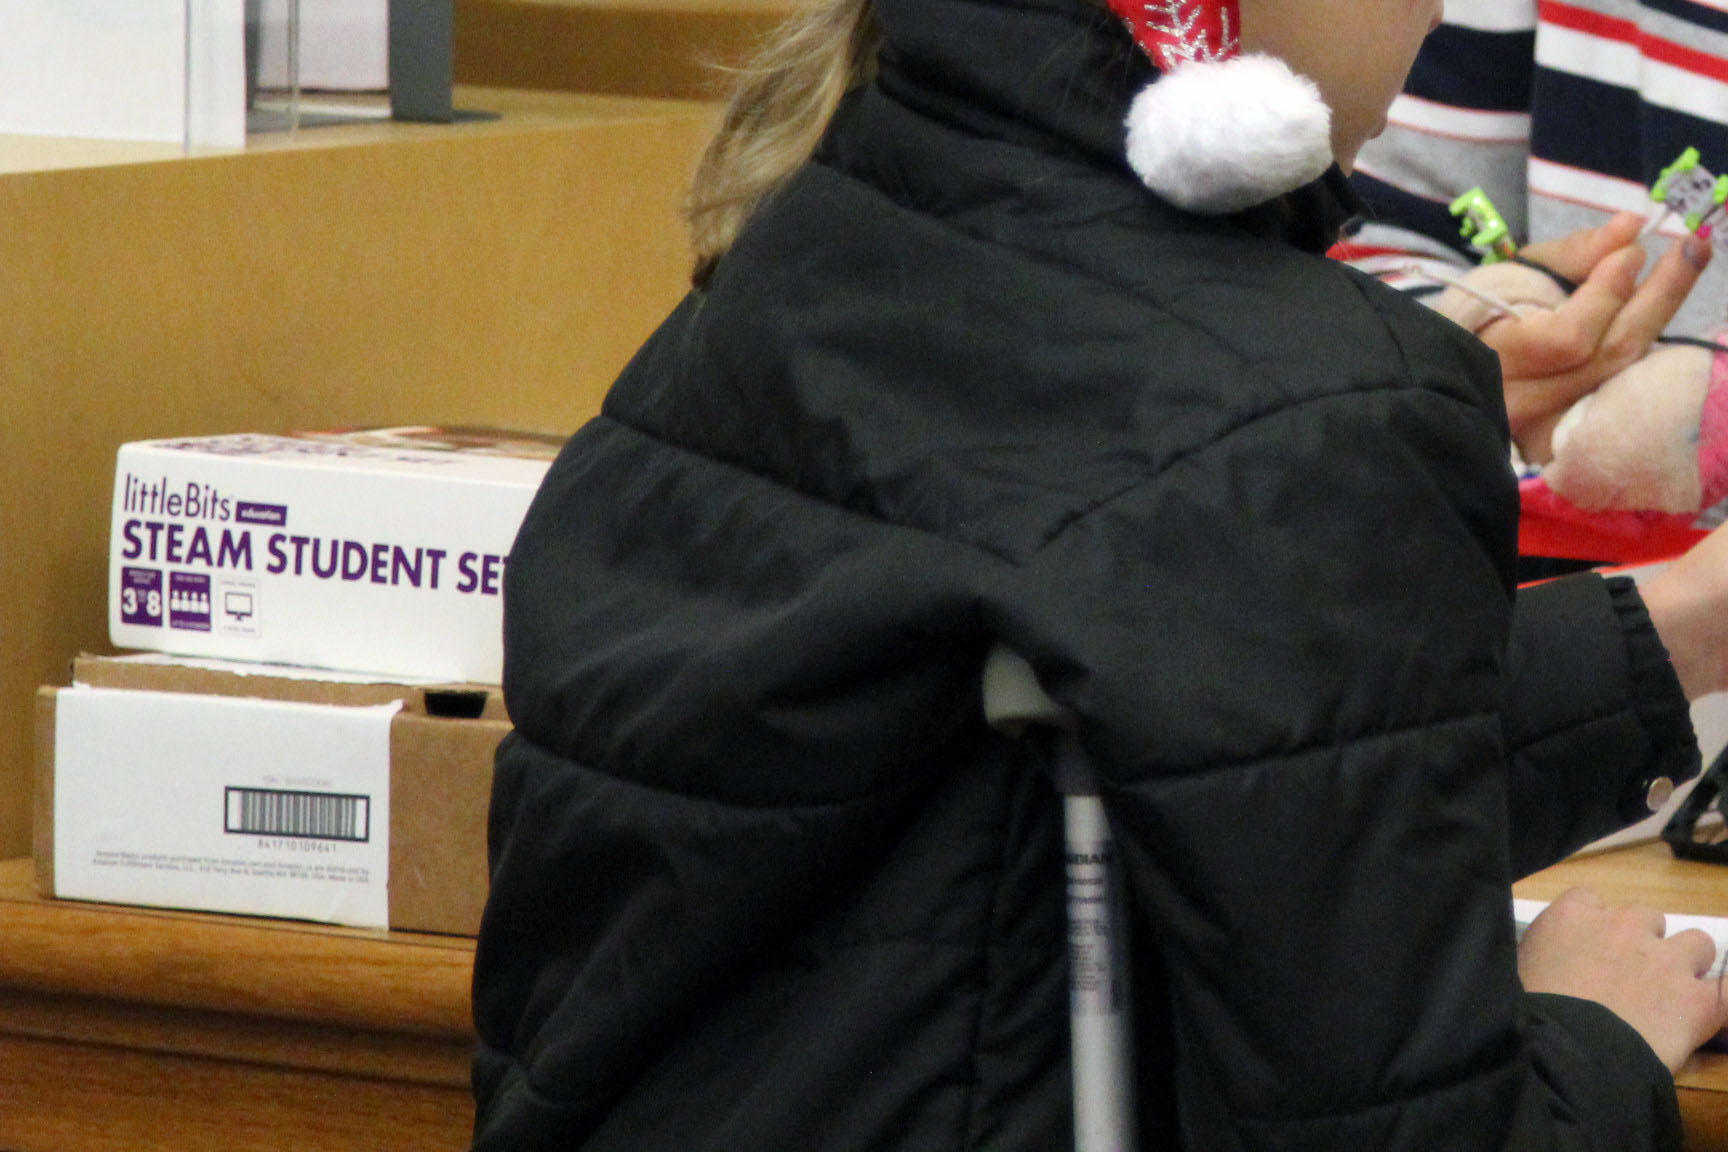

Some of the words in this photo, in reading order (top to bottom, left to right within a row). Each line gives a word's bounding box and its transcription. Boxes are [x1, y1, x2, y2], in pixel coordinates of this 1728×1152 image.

[124, 472, 231, 521] littleBits
[121, 519, 253, 570] STEAM
[266, 533, 447, 589] STUDENT
[122, 587, 138, 615] 3
[146, 589, 162, 617] 8
